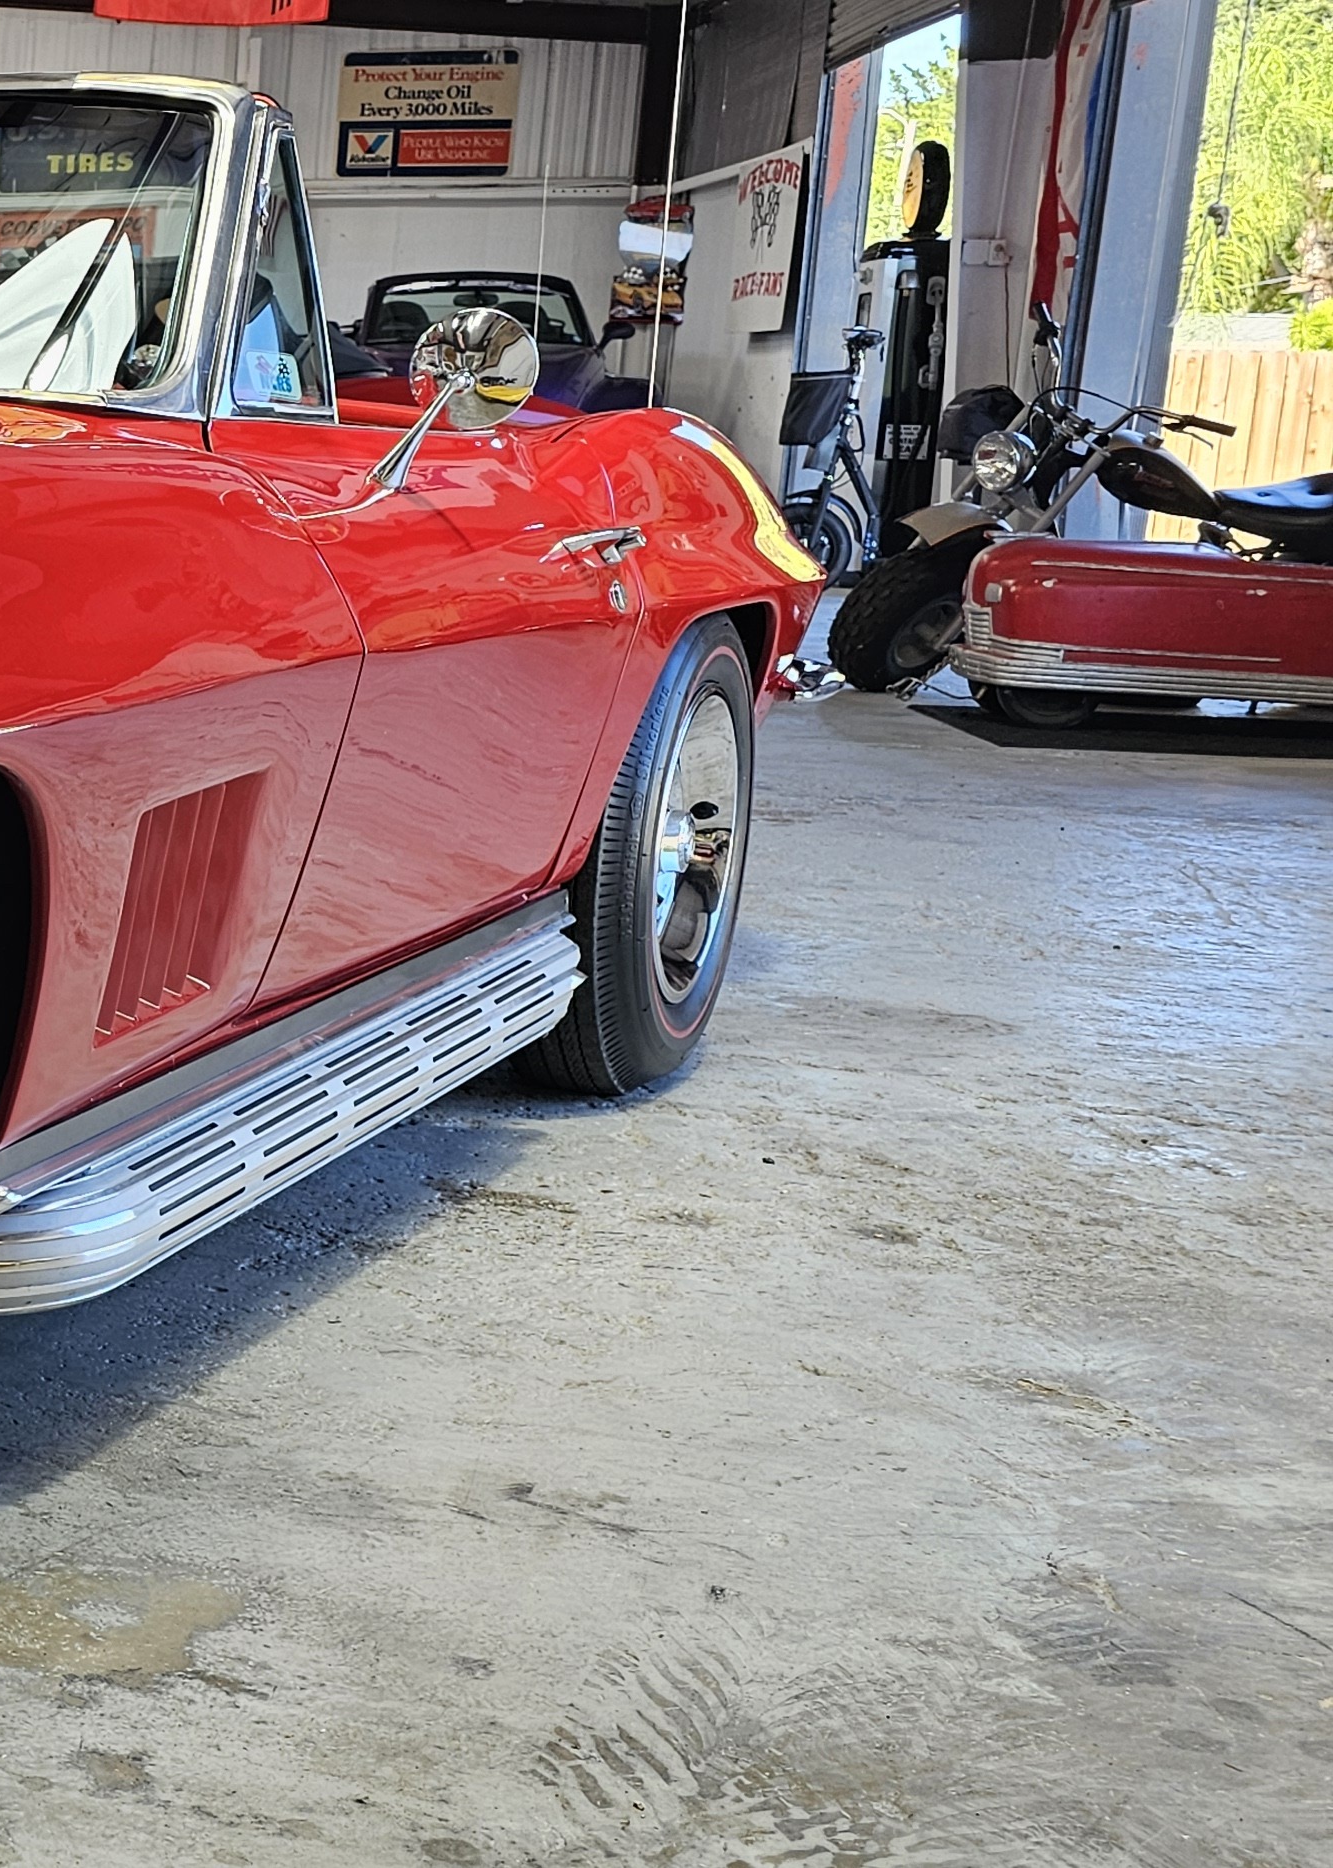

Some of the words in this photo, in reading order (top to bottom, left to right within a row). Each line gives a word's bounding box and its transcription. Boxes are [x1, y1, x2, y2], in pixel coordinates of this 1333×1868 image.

[353, 68, 408, 82] Protect
[412, 68, 445, 82] Your
[449, 67, 504, 83] Engine
[384, 85, 443, 101] Change
[446, 85, 471, 100] Oil
[360, 103, 402, 119] Every
[449, 102, 493, 116] Miles
[46, 151, 134, 174] TIRES
[738, 158, 800, 205] WELCOME
